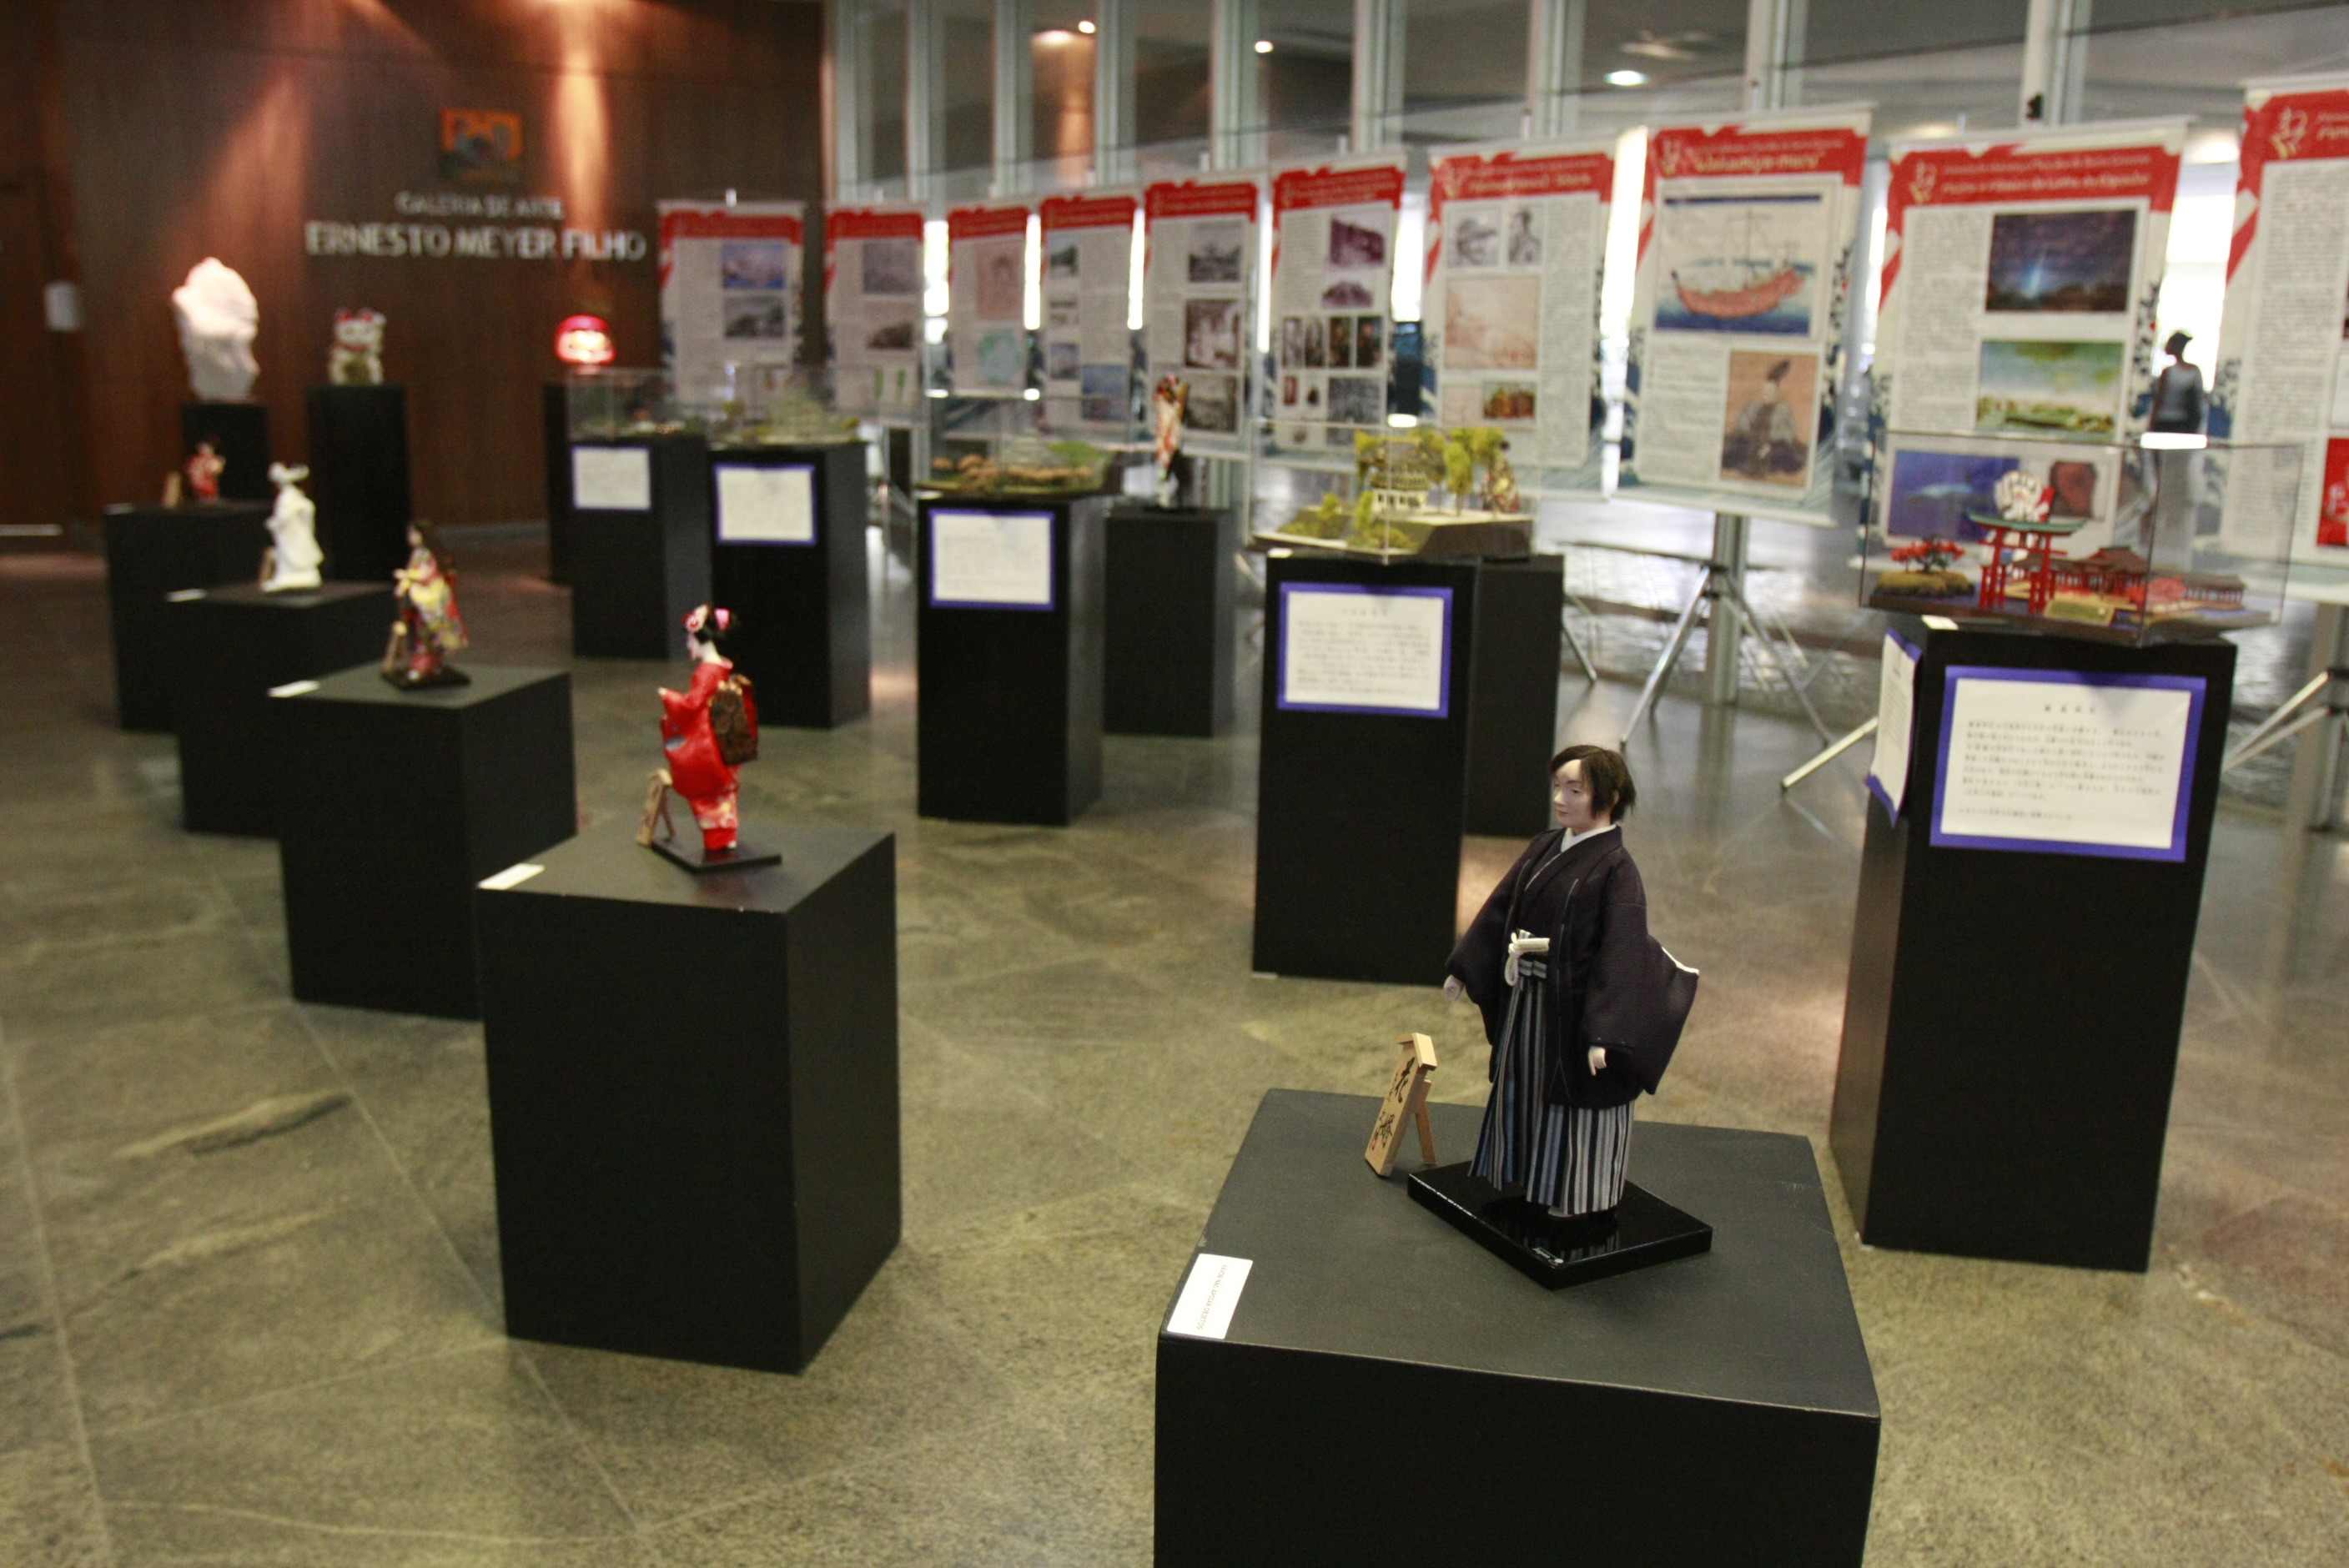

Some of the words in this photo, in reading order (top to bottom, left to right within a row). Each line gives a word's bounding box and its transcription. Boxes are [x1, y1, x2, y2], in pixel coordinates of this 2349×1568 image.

[395, 191, 484, 216] GALERIA
[484, 194, 511, 218] DE
[514, 197, 565, 220] ARTE
[304, 221, 451, 257] ERNESTO
[455, 226, 556, 259] MEYER
[562, 229, 647, 261] FILHO
